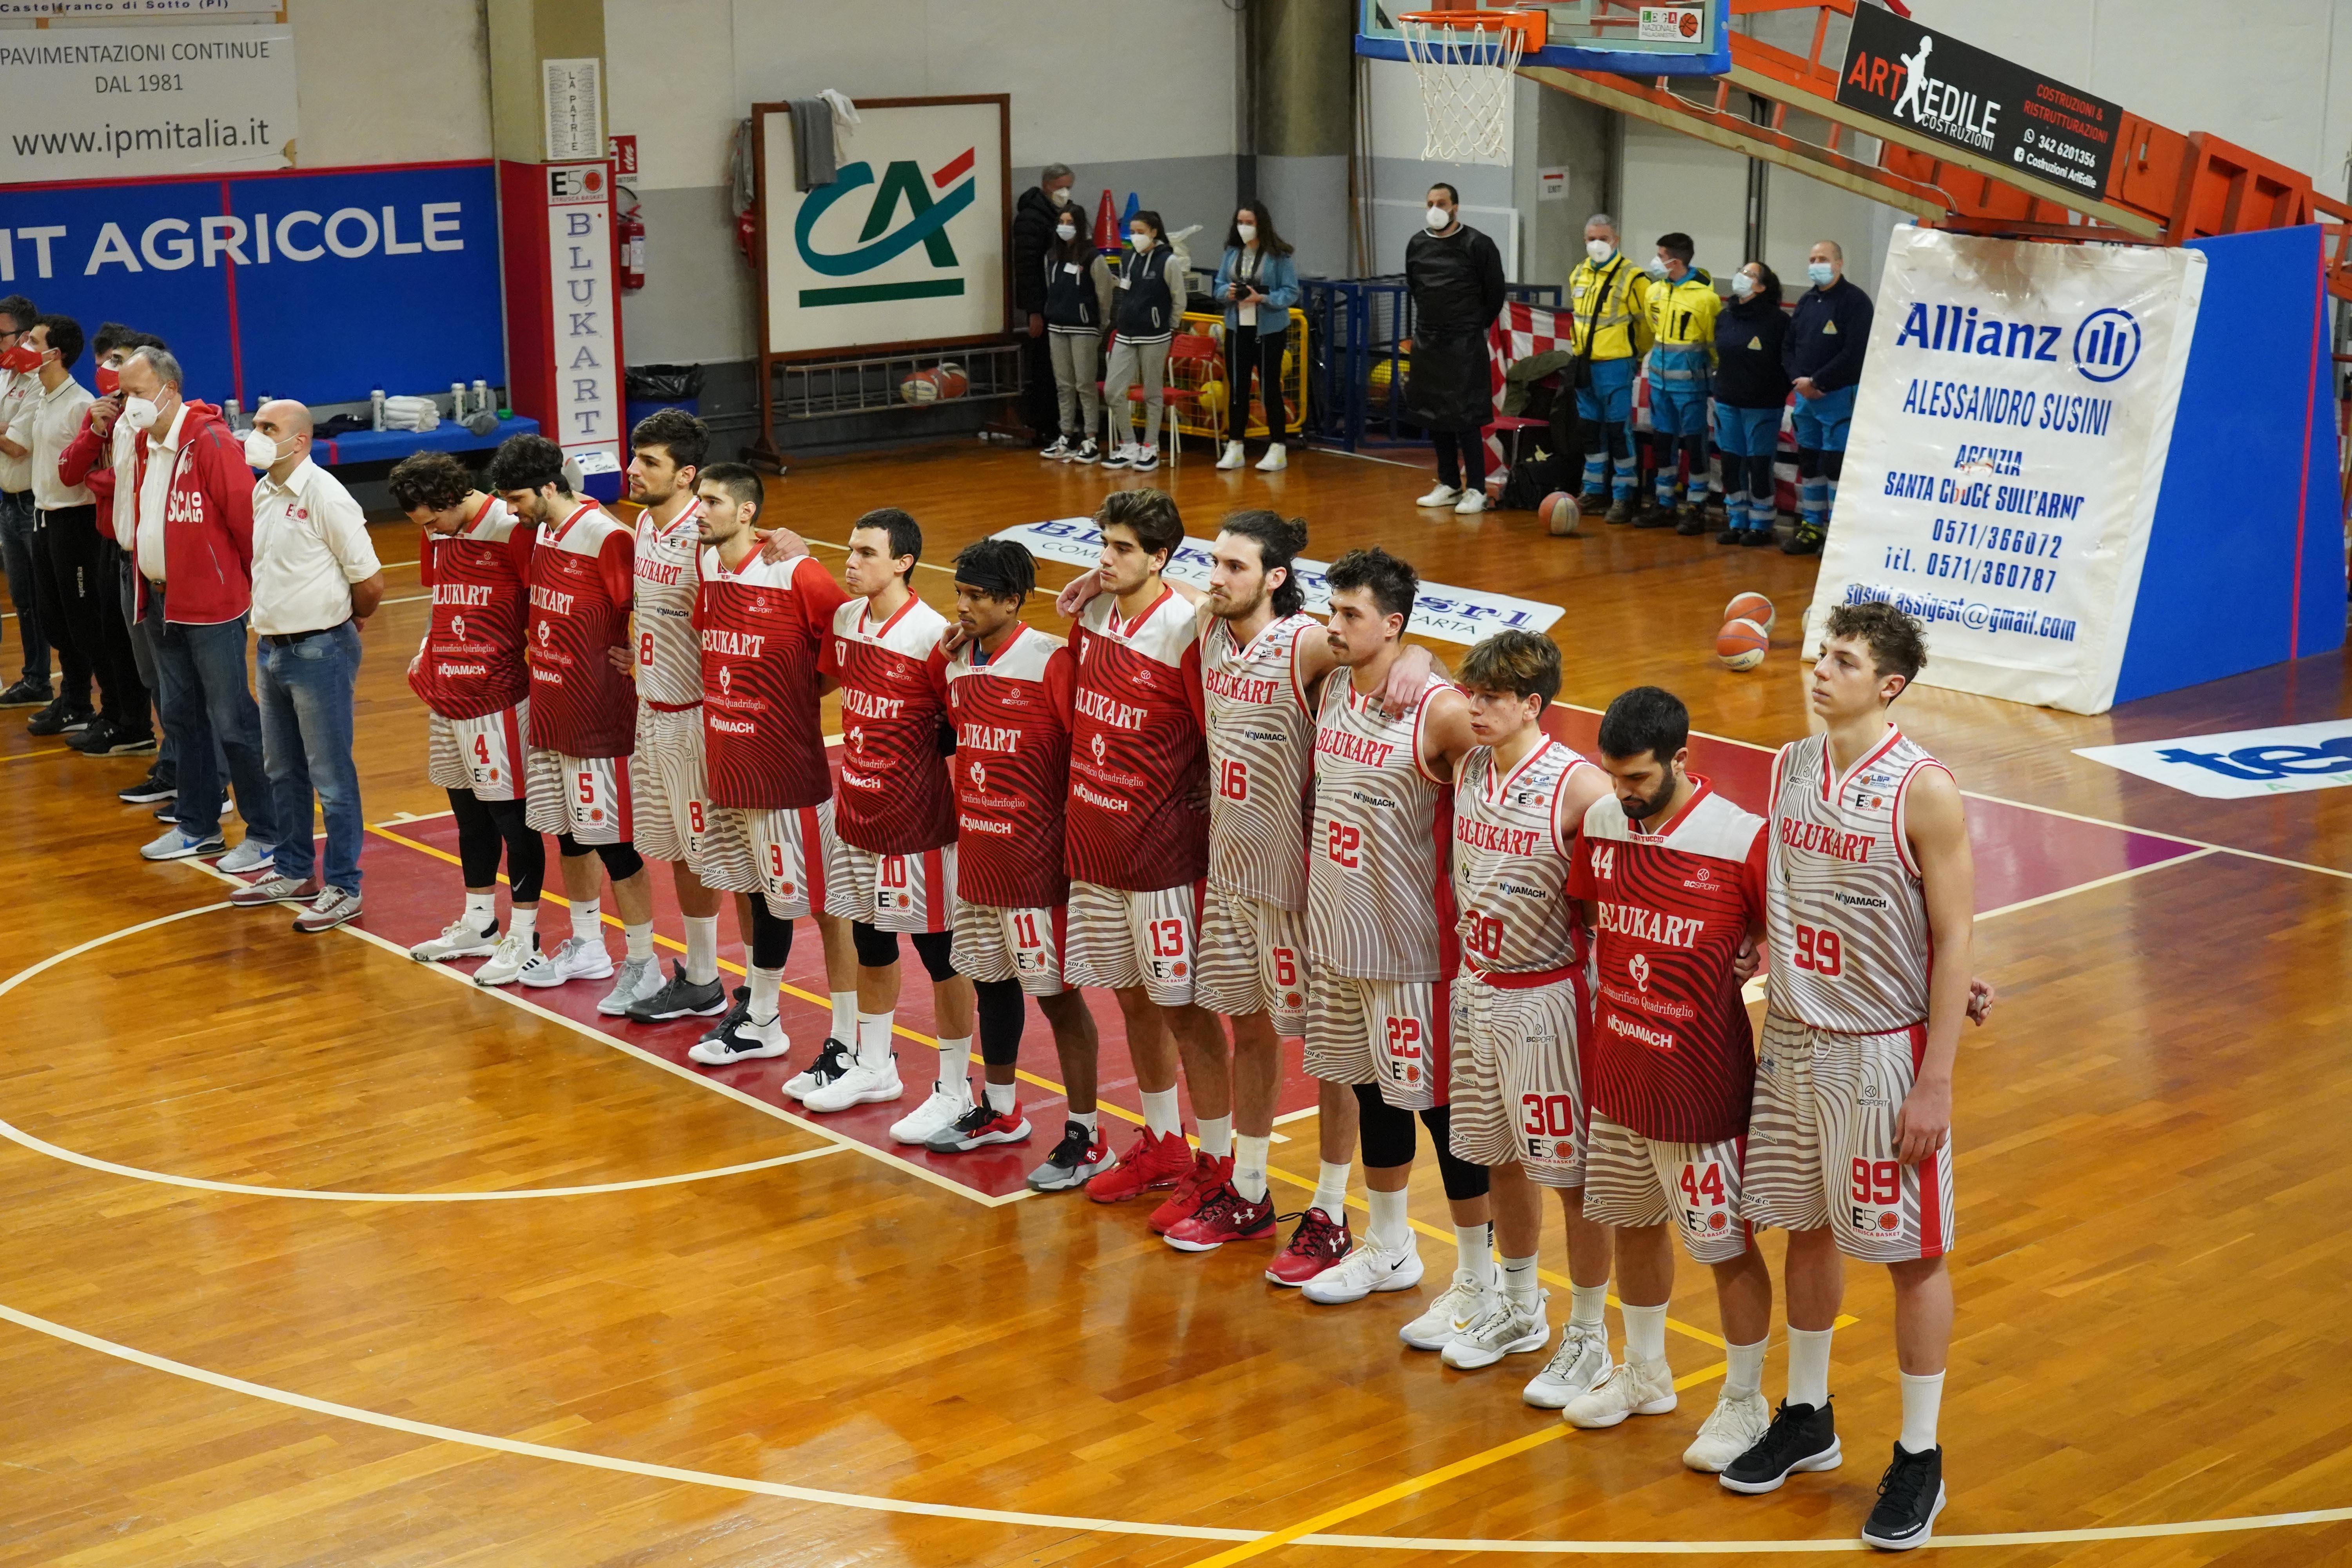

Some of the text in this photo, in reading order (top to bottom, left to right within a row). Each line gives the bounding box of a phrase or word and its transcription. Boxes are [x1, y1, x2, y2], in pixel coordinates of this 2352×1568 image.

[0, 0, 229, 13] Castelfranco di Sotto (PI)
[1642, 11, 1677, 24] LEGA
[1642, 24, 1677, 32] NAZIONALE
[1, 41, 270, 65] PAVIMENTAZIONI CONTINUE
[95, 73, 183, 94] DAL 1981
[1847, 51, 2001, 139] ART EDILE
[2036, 83, 2103, 121] COSTRUZIONI &
[13, 118, 270, 158] www.ipmitalia.it
[1922, 113, 1995, 151] COSTRUZIONI
[2023, 100, 2109, 144] RISTRUTTURAZIONI
[2026, 152, 2069, 178] Costruzioni
[2038, 135, 2096, 168] 342 6201356
[83, 201, 464, 276] AGRICOLE
[1896, 302, 2062, 362] Allianz
[1903, 378, 2112, 436] ALESSANDRO SUSINI
[1884, 471, 1935, 501] SANTA
[1932, 518, 2062, 559] 0571/366072
[634, 556, 682, 586] BLUKART
[1926, 552, 2056, 593] 0571/360787
[1414, 595, 1532, 630] srl
[1846, 583, 2076, 642] susiniassigest@gmail.com
[640, 632, 653, 666] 8
[886, 670, 913, 682] BCSPORT
[1205, 667, 1279, 705] BLUKART
[725, 697, 766, 710] Quadrifoglio
[1002, 698, 1030, 706] BCSPORT
[710, 714, 754, 733] NOVAMACH
[956, 723, 1022, 753] LUKART
[1245, 729, 1287, 742] NOVAMACH
[474, 734, 490, 764] 4
[1316, 727, 1394, 768] BLUKART
[578, 773, 594, 804] 5
[1098, 769, 1143, 787] Quadrifoglio
[1220, 759, 1247, 801] 16
[1789, 776, 1817, 787] BCSPORT
[981, 795, 1025, 809] Quadrifoglio
[1073, 783, 1128, 811] NOVAMACH
[1354, 791, 1396, 808] NOVAMACH
[689, 801, 706, 833] 8
[960, 813, 1011, 834] NOVAMACH
[1328, 820, 1359, 868] 22
[1457, 815, 1540, 857] BLUKART
[1782, 817, 1876, 864] BLUKART
[771, 844, 784, 877] 9
[880, 855, 906, 888] 10
[1591, 845, 1614, 880] 44
[1499, 881, 1546, 898] NOVAMACH
[1683, 880, 1720, 892] BCSPORT
[1835, 891, 1887, 908] NOVAMACH
[1014, 913, 1041, 949] 11
[1149, 919, 1183, 957] 13
[1465, 910, 1504, 960] 30
[1598, 901, 1704, 949] BLUKART
[1272, 946, 1296, 986] 16
[1793, 924, 1841, 977] 99
[1598, 982, 1694, 1019] Calzaturificio Quadrifoglio
[1386, 1016, 1421, 1058] 22
[1608, 1013, 1672, 1049] NOVAMACH
[1521, 1094, 1574, 1137] 30
[1856, 1099, 1889, 1107] BCSPORT
[1756, 1131, 1777, 1143] ITALIANA
[1087, 1150, 1097, 1161] 45
[1680, 1163, 1725, 1207] 44
[1852, 1157, 1900, 1205] 99
[1707, 1229, 1729, 1238] BASKET
[1852, 1227, 1874, 1237] ETRUSCA
[1907, 1522, 1922, 1533] ARMOUR
